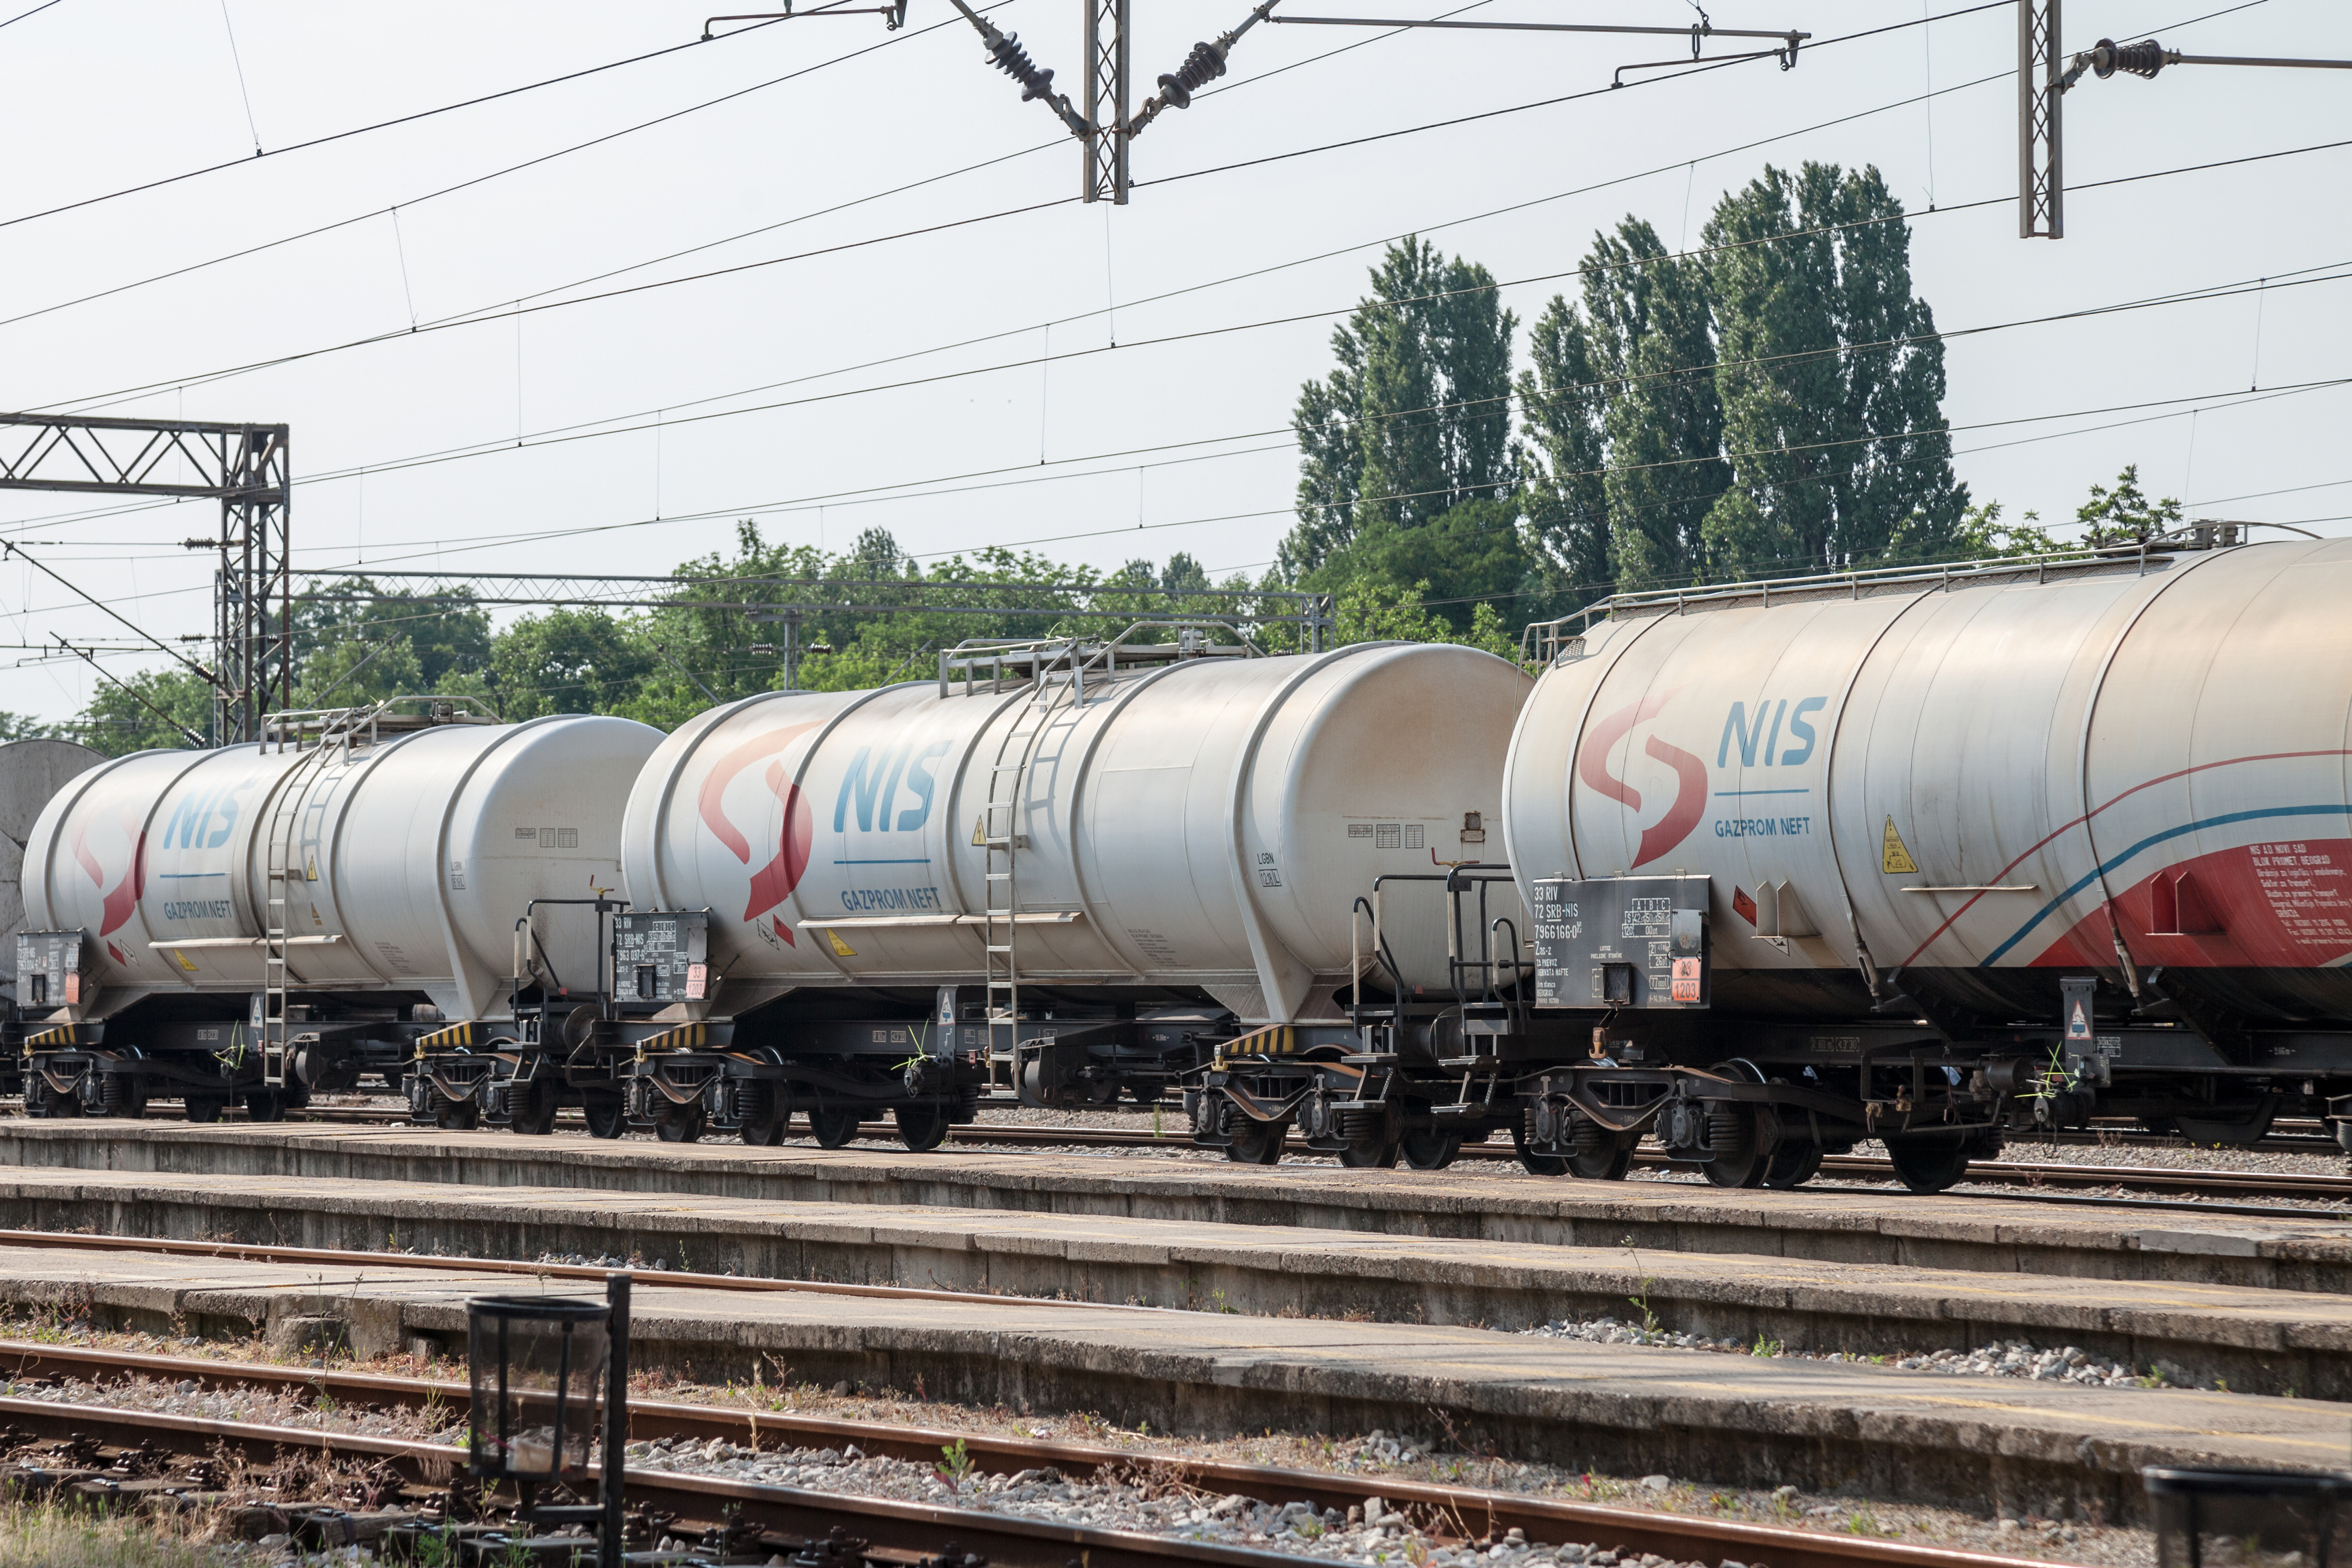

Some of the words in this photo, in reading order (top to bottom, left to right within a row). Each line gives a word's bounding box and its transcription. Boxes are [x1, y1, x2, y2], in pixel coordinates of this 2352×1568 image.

[1718, 696, 1828, 768] NIS
[834, 740, 954, 833] NIS
[163, 777, 259, 849] NIS
[1715, 818, 1777, 837] GAZPROM
[1780, 817, 1809, 835] NEFT
[1257, 852, 1274, 864] LGBN
[841, 889, 908, 911] GAZPROM
[906, 887, 941, 909] NEFT
[1535, 887, 1544, 901] 33
[1546, 886, 1558, 901] RIV
[164, 901, 209, 920] GAZPROM
[209, 901, 232, 918] NEFT
[1535, 904, 1544, 918] 72
[1546, 903, 1578, 918] SRB-NIS
[1637, 901, 1641, 910] A
[1649, 900, 1653, 910] B
[1662, 900, 1665, 910] C
[615, 917, 622, 928] 33
[1628, 913, 1631, 922] S
[1624, 926, 1632, 935] 120
[616, 934, 622, 945] 72
[624, 934, 644, 945] SRB-NIS
[616, 950, 629, 961] 7963
[694, 967, 700, 978] 33
[689, 984, 702, 995] 1203
[1675, 983, 1696, 998] 1203
